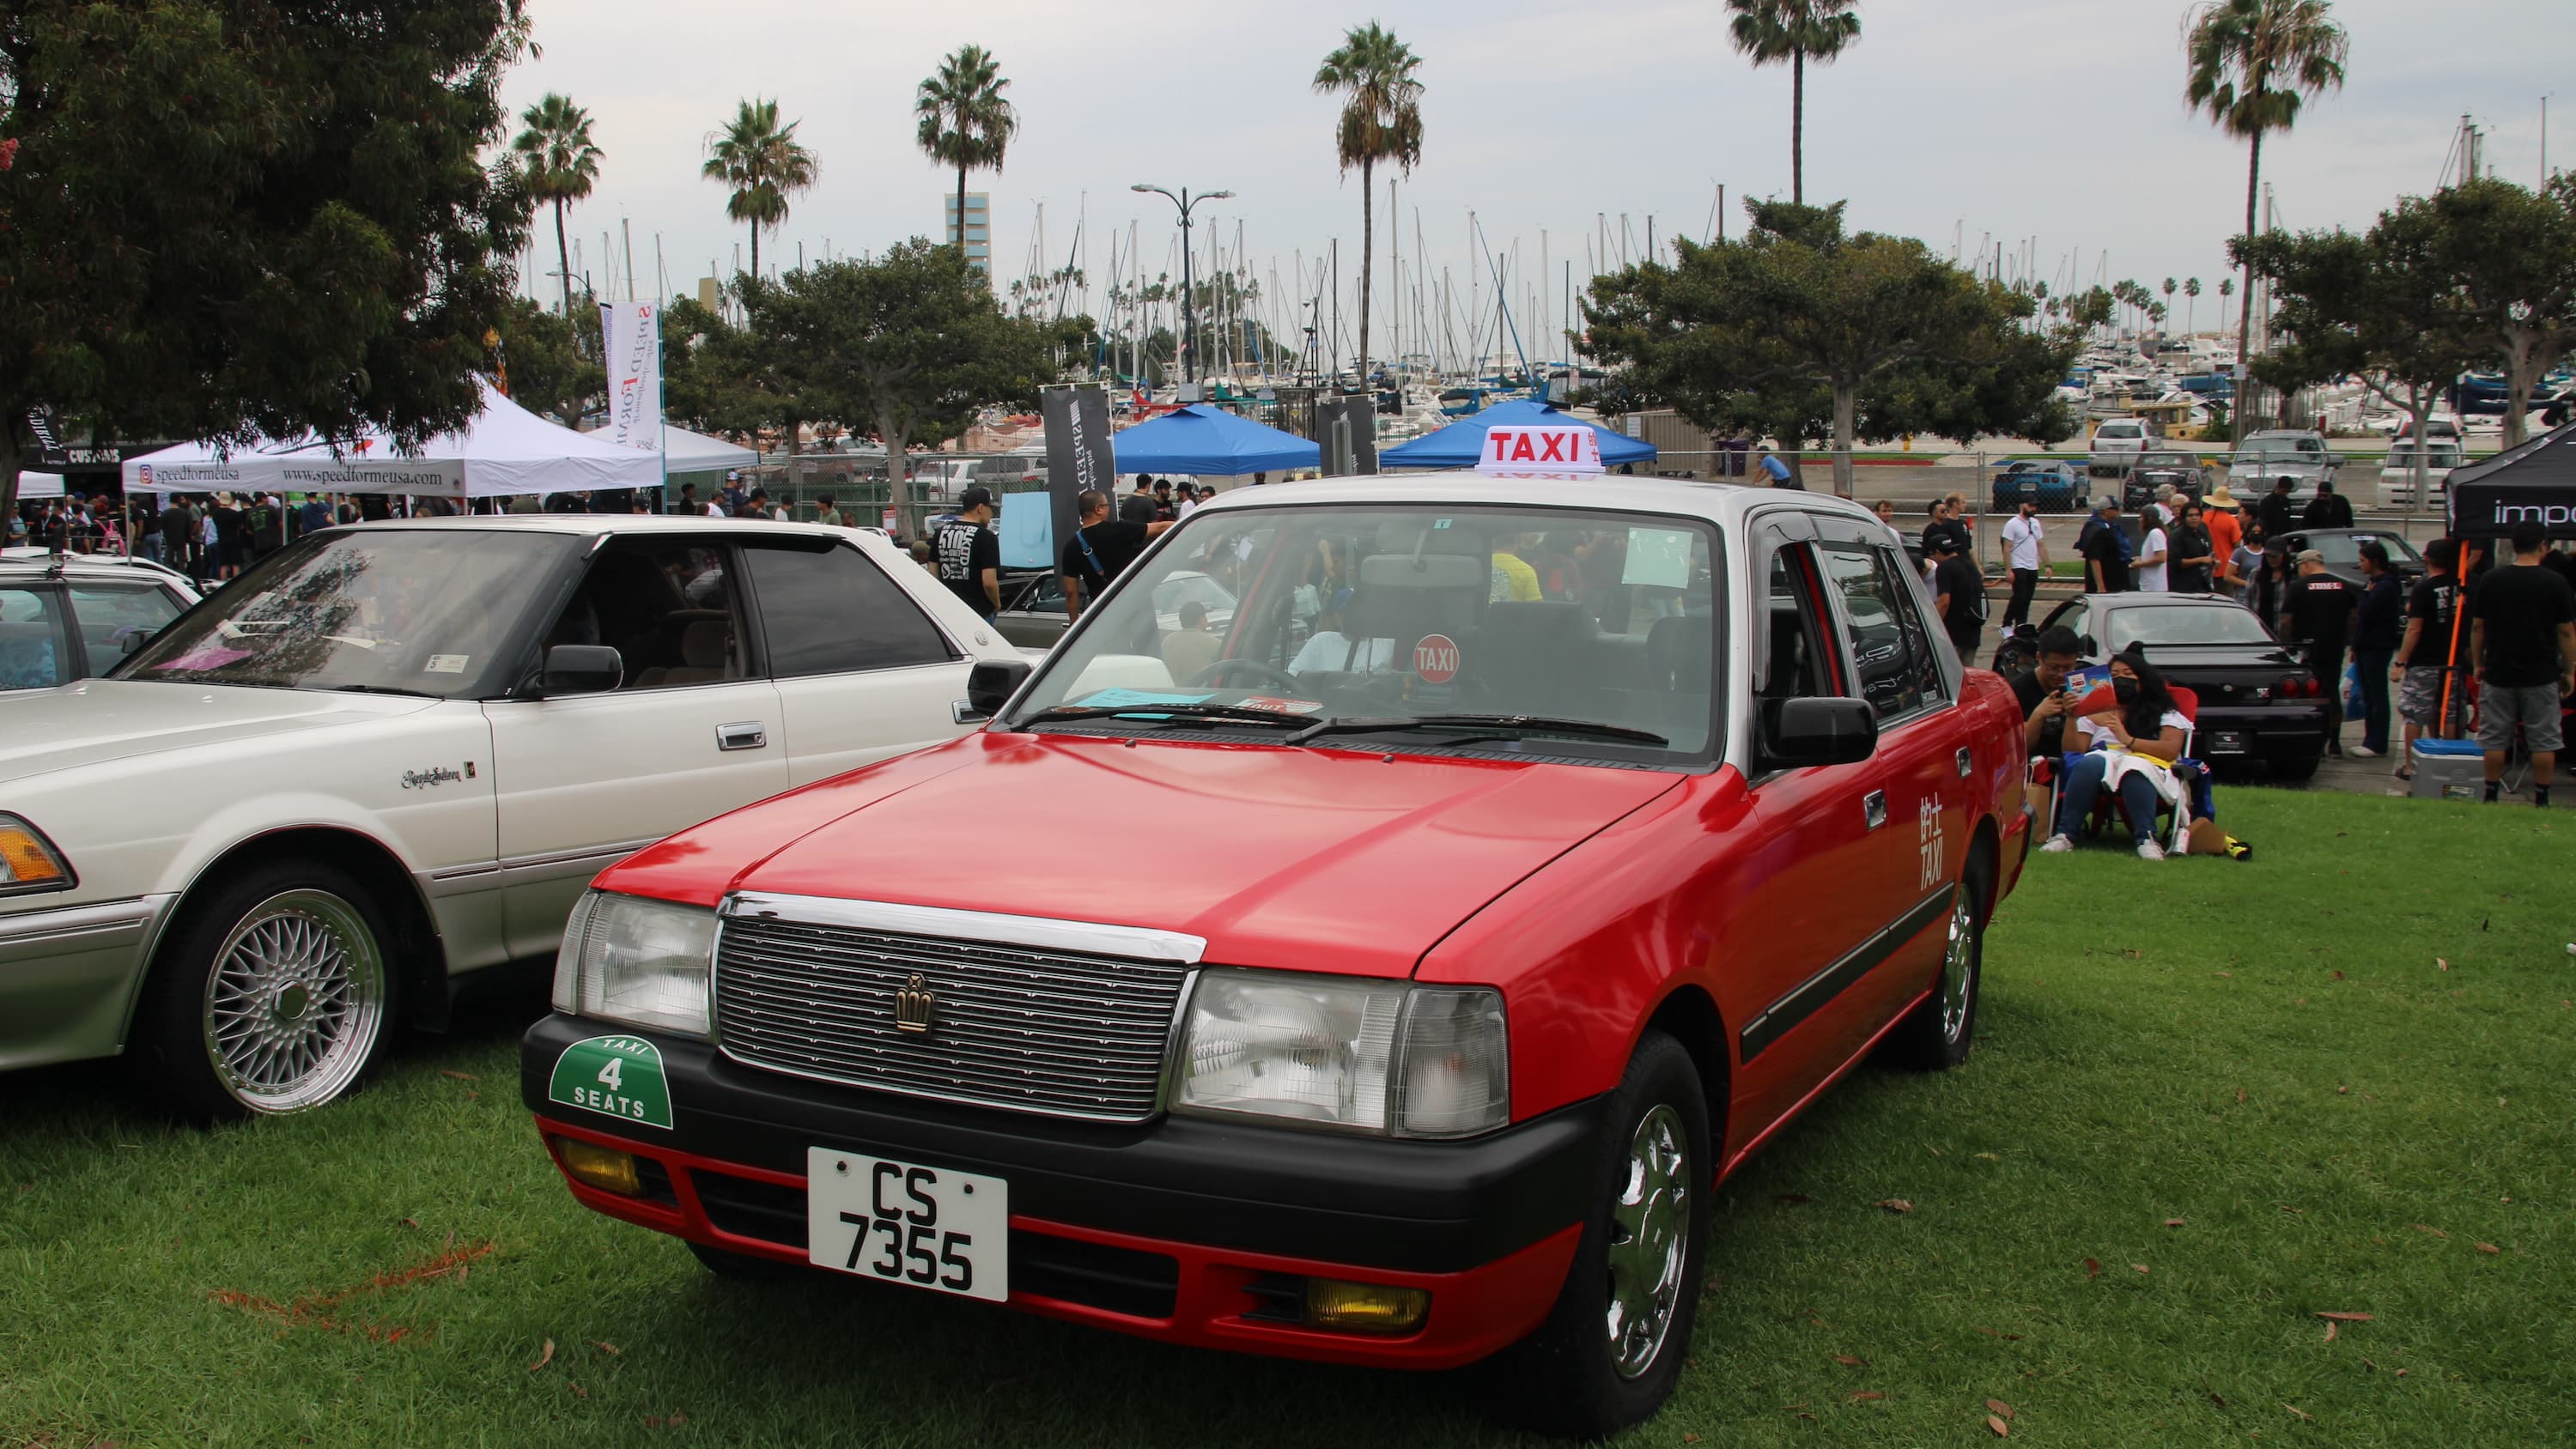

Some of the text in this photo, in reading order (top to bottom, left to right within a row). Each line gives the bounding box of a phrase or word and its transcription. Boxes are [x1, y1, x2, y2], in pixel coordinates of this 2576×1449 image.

[1491, 433, 1579, 462] TAXI
[156, 464, 240, 483] speedformeusa
[283, 466, 443, 488] www.speedformeusa.com
[939, 529, 963, 549] 510
[1418, 647, 1455, 671] TAXI
[1920, 835, 1943, 891] TAXI
[603, 1039, 648, 1055] TAXI
[598, 1057, 623, 1091] 4
[574, 1086, 645, 1119] SEATS
[872, 1161, 937, 1227] CS
[839, 1211, 972, 1291] 7355
